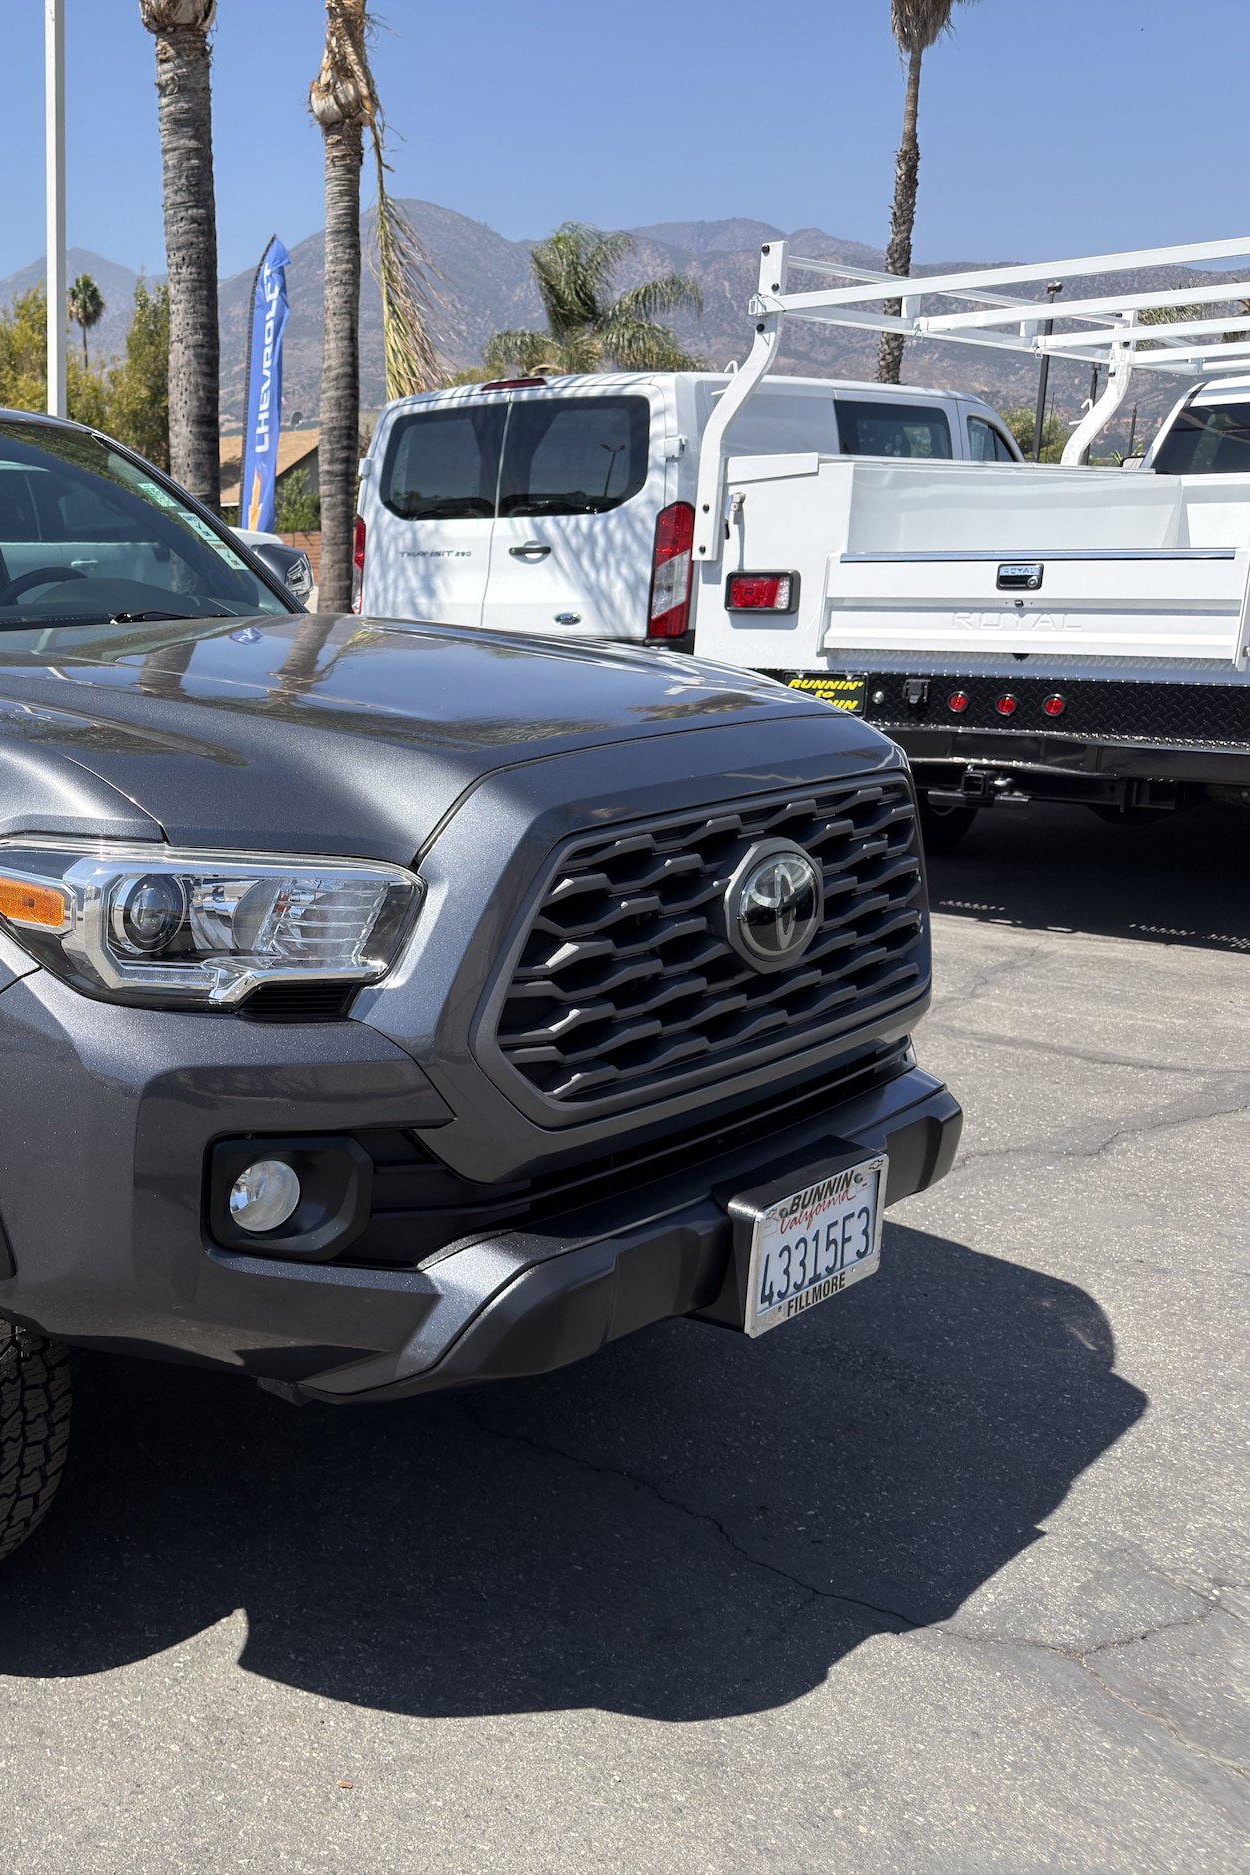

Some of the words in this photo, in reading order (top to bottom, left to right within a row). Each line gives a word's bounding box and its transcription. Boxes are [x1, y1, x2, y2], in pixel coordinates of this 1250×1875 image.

[1003, 567, 1035, 575] ROYAL
[952, 612, 1083, 631] ROYAL
[788, 679, 864, 691] RUNNIN'
[815, 690, 835, 698] to
[789, 1170, 854, 1216] BUNNIN
[760, 1206, 870, 1307] 43315F3
[787, 1272, 846, 1317] FILLMORE
